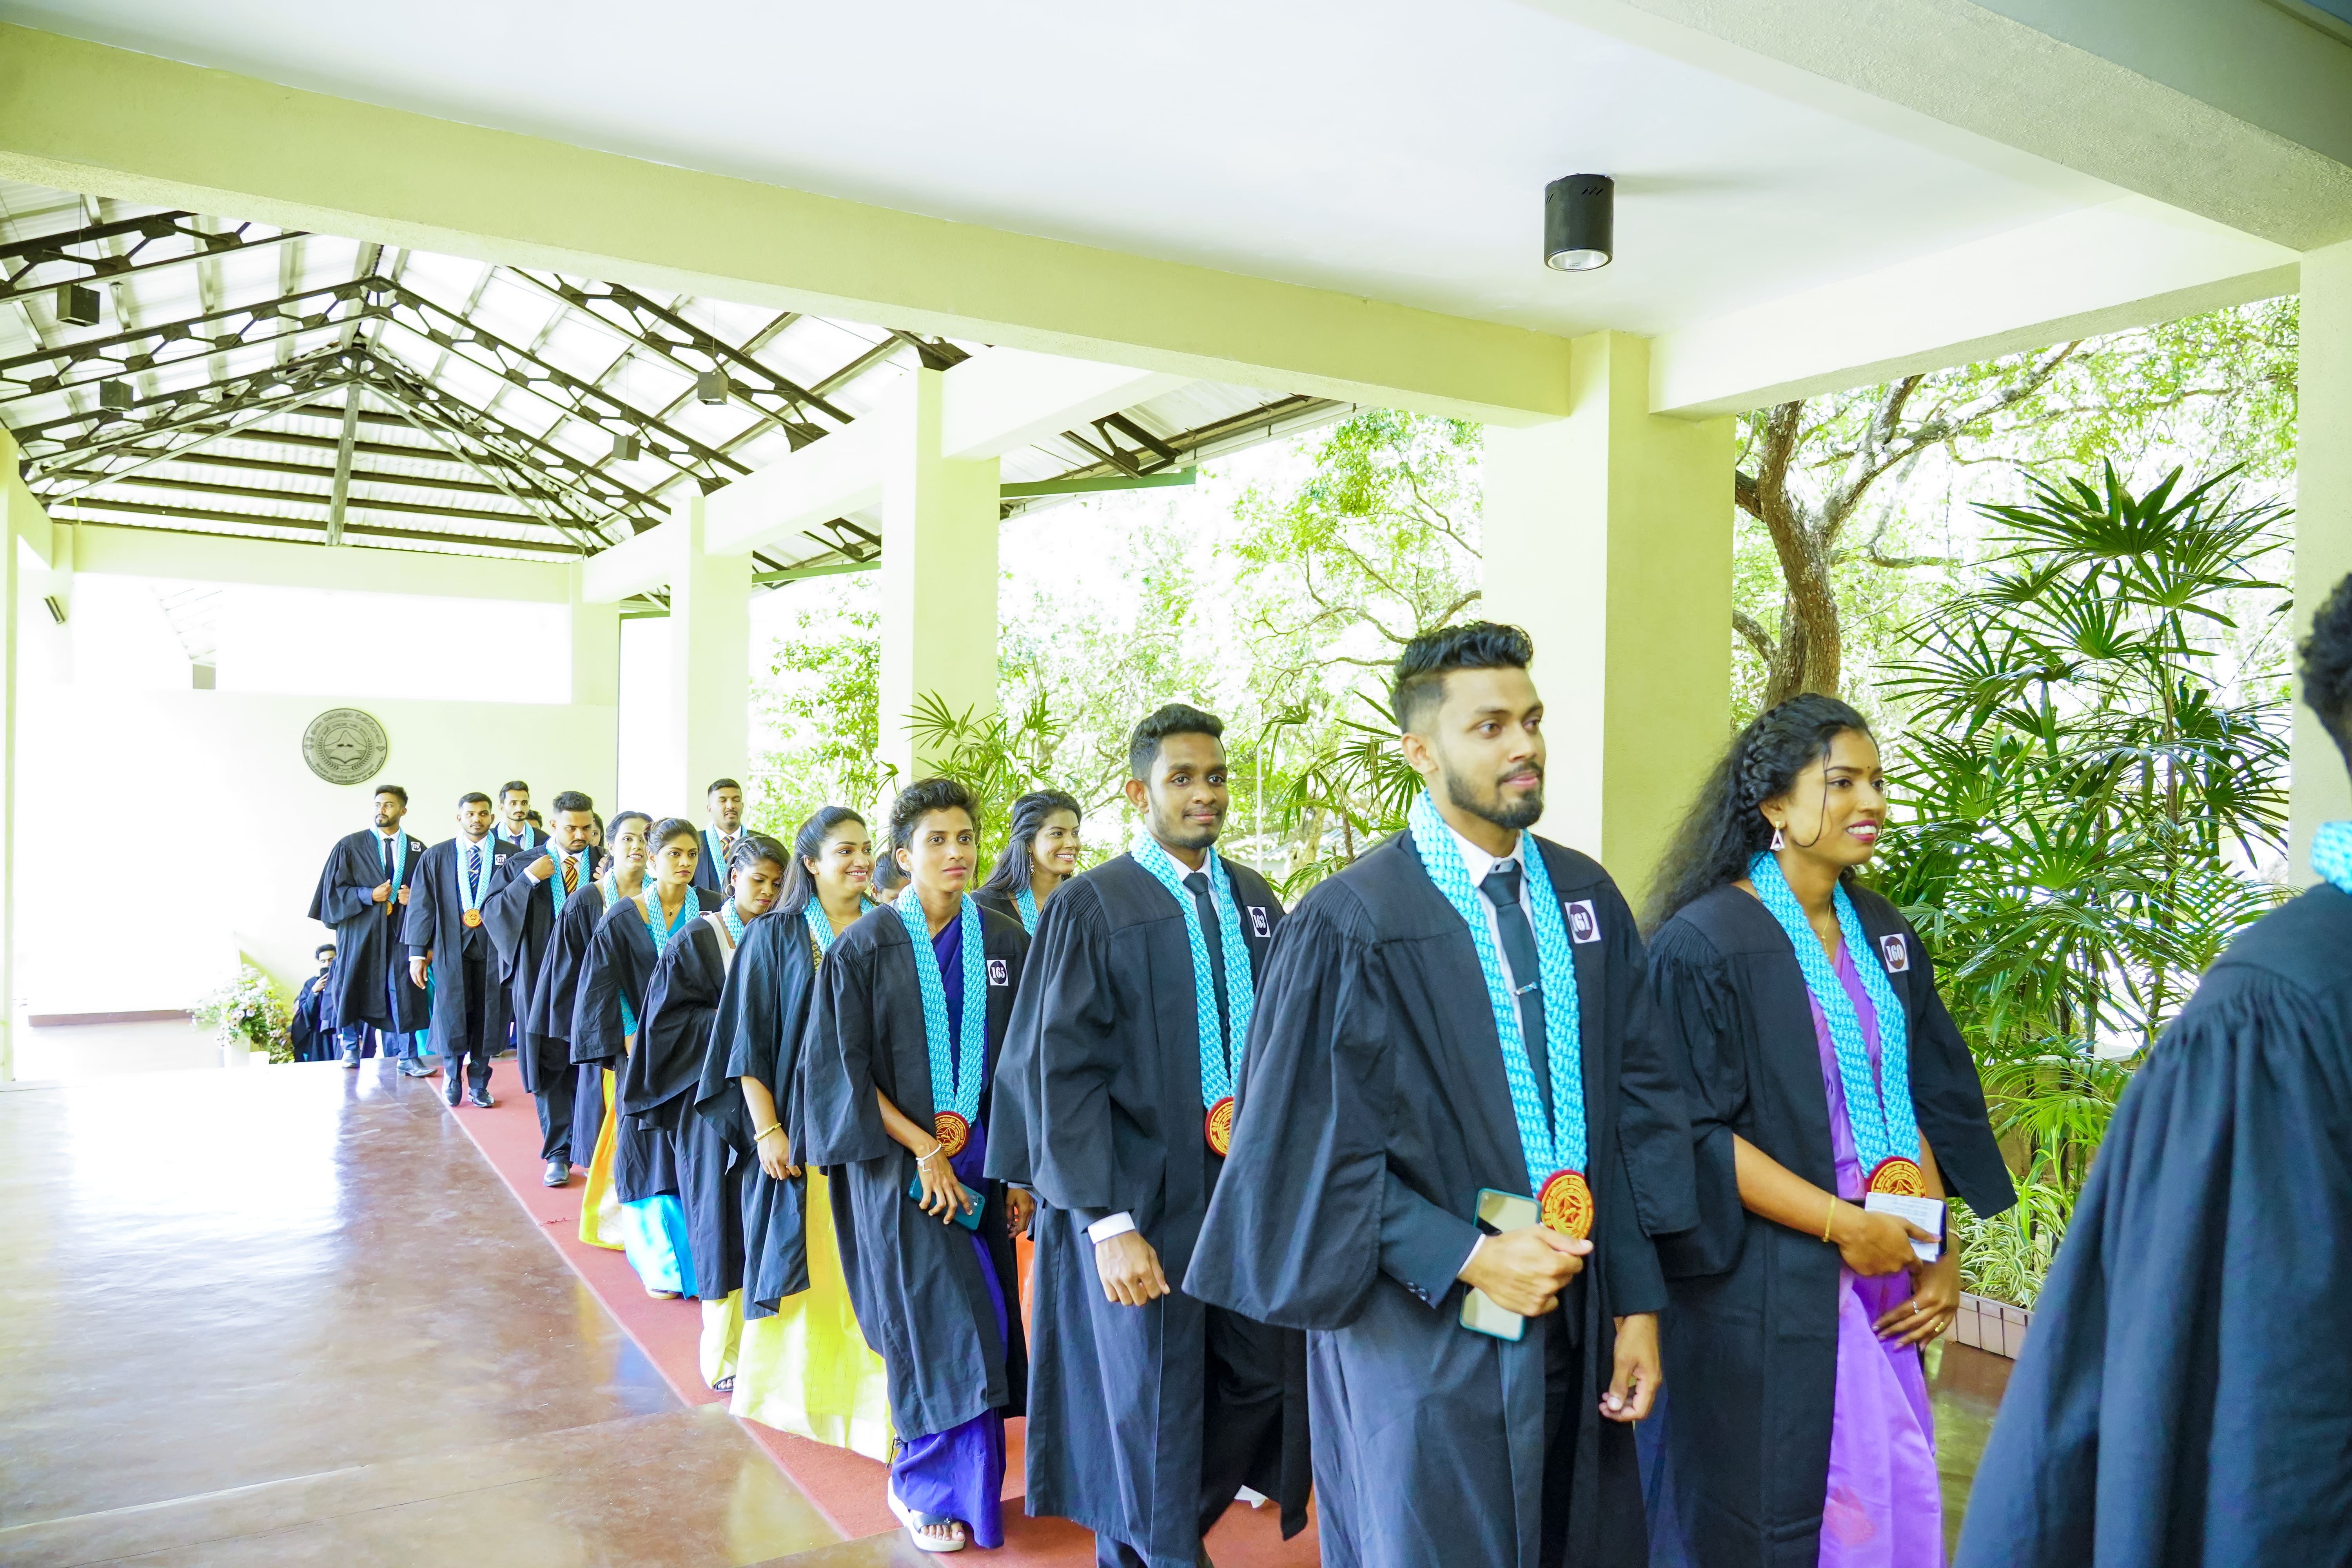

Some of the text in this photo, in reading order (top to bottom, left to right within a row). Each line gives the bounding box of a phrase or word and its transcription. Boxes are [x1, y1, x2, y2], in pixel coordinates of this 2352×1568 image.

[1253, 915, 1266, 929] 163
[1570, 912, 1591, 932] 161
[1886, 944, 1904, 962] 160
[991, 967, 1005, 978] 165
